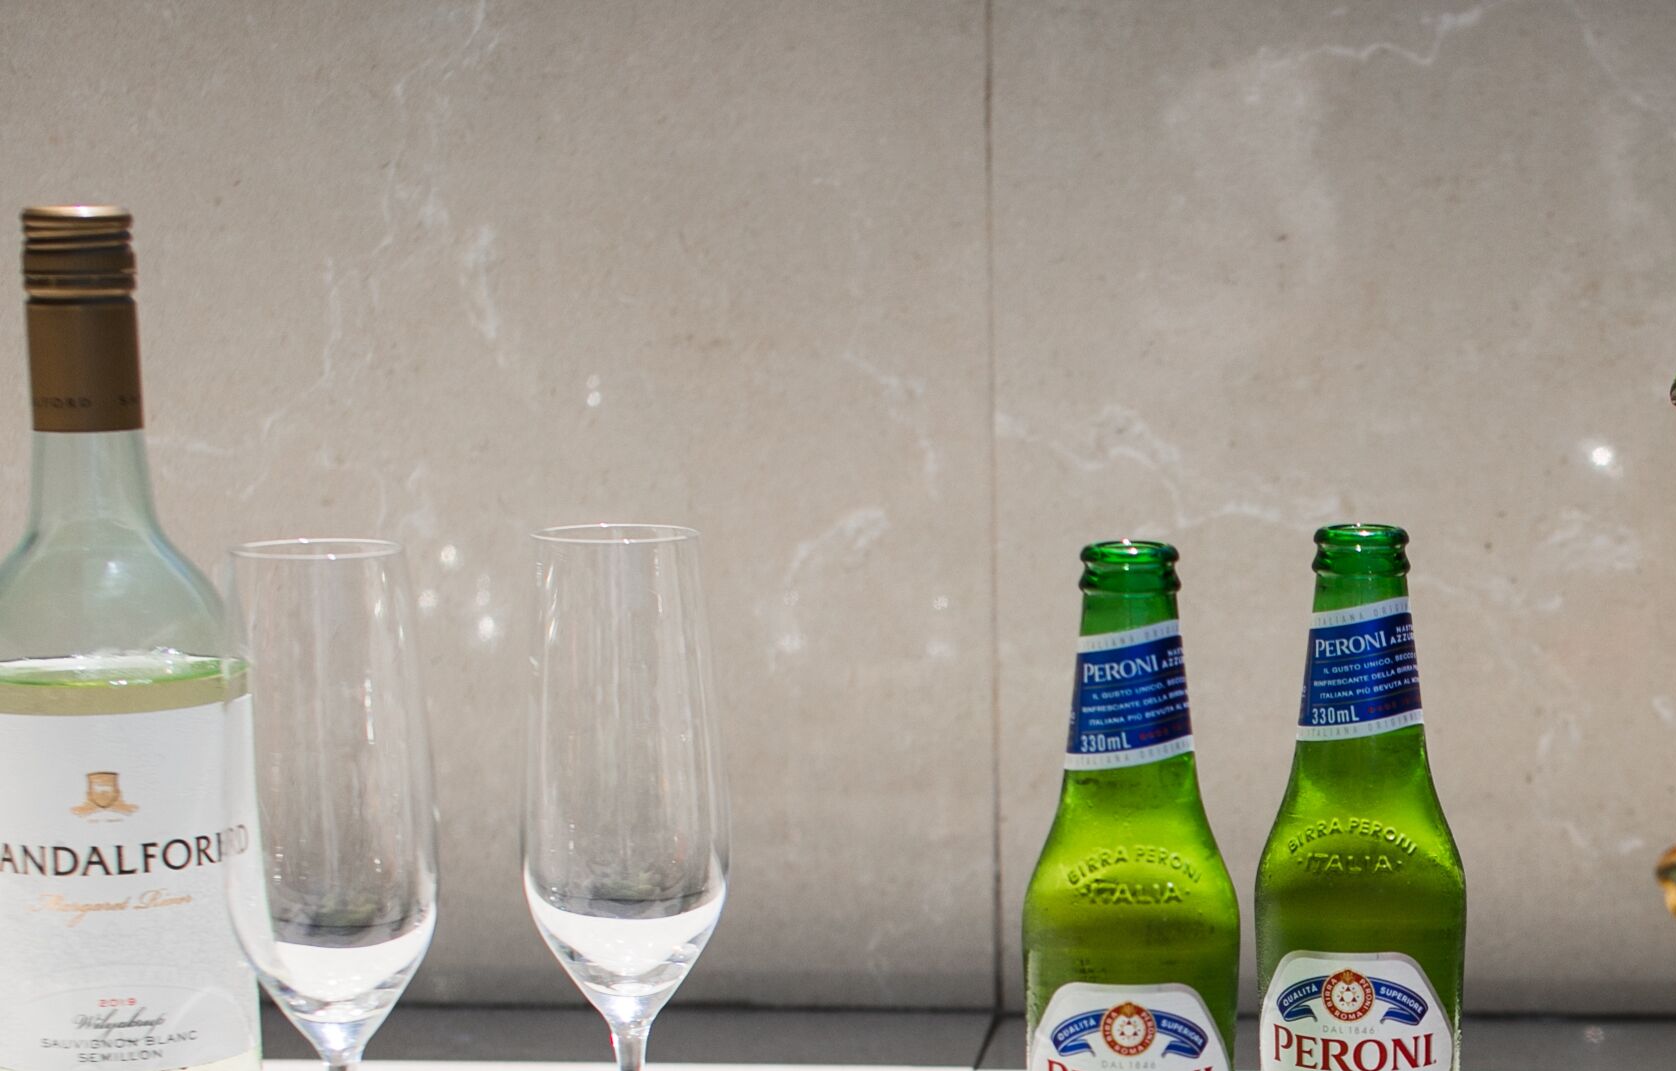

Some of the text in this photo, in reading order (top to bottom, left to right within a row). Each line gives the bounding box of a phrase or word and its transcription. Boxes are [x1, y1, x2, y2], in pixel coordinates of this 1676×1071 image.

[1315, 630, 1387, 658] PERONI
[1083, 654, 1159, 684] PERONI
[1313, 675, 1369, 688] RINFRESCANTE
[1371, 669, 1395, 681] DELLA
[1332, 663, 1360, 674] GUSTO
[1320, 690, 1353, 700] ITALIANA
[1373, 680, 1402, 693] BEVUTA
[1312, 704, 1360, 725] 330mL
[1080, 731, 1132, 753] 330mL
[1288, 817, 1418, 855] BIRRA PERONI
[1066, 843, 1202, 886] BIRRA PERONI
[1283, 983, 1424, 1015] QUALITÀ SUPERIORE
[1324, 977, 1371, 1012] BIRRA PERONI
[1333, 1009, 1363, 1021] ROMA
[144, 1029, 198, 1046] BLANC
[1322, 1025, 1376, 1035] DAL 1846
[77, 1049, 163, 1063] SEMILLON
[1101, 1060, 1125, 1070] DAL
